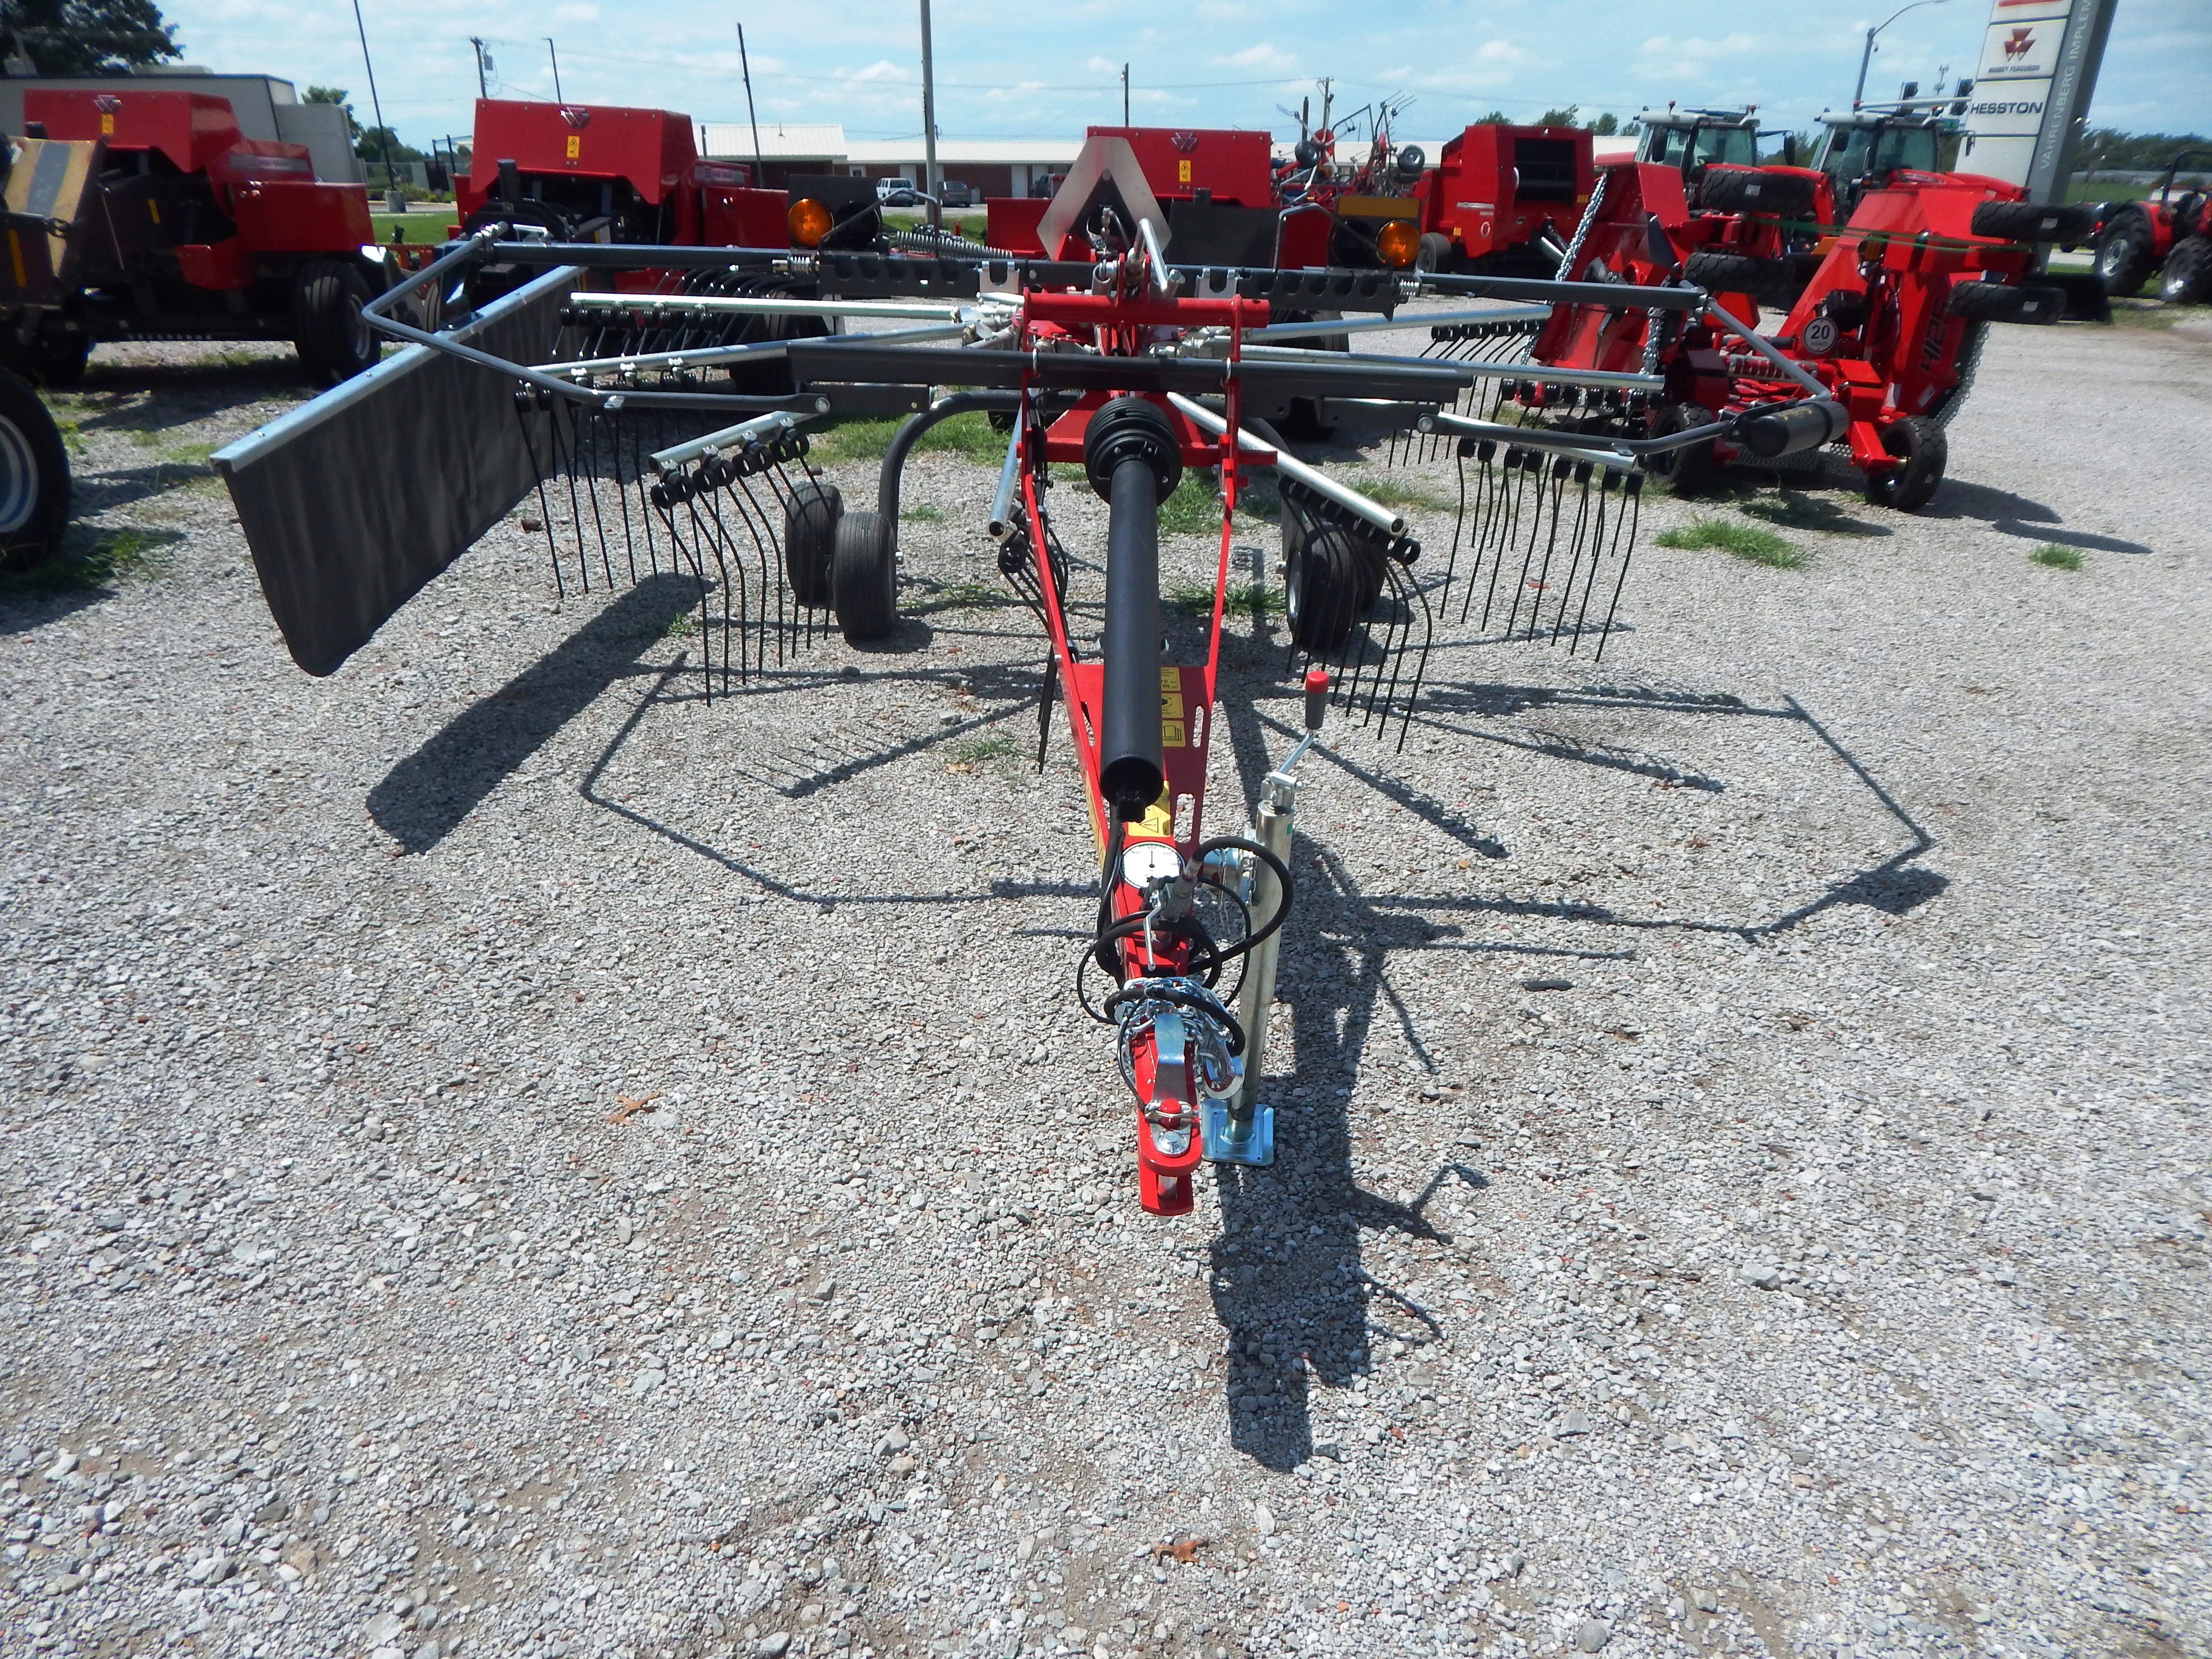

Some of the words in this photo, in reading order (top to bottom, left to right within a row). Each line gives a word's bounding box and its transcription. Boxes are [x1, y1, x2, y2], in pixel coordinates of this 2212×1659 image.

[1970, 102, 2043, 114] HESSTON
[2041, 65, 2076, 168] VAHRENBERG
[1811, 325, 1830, 339] 20
